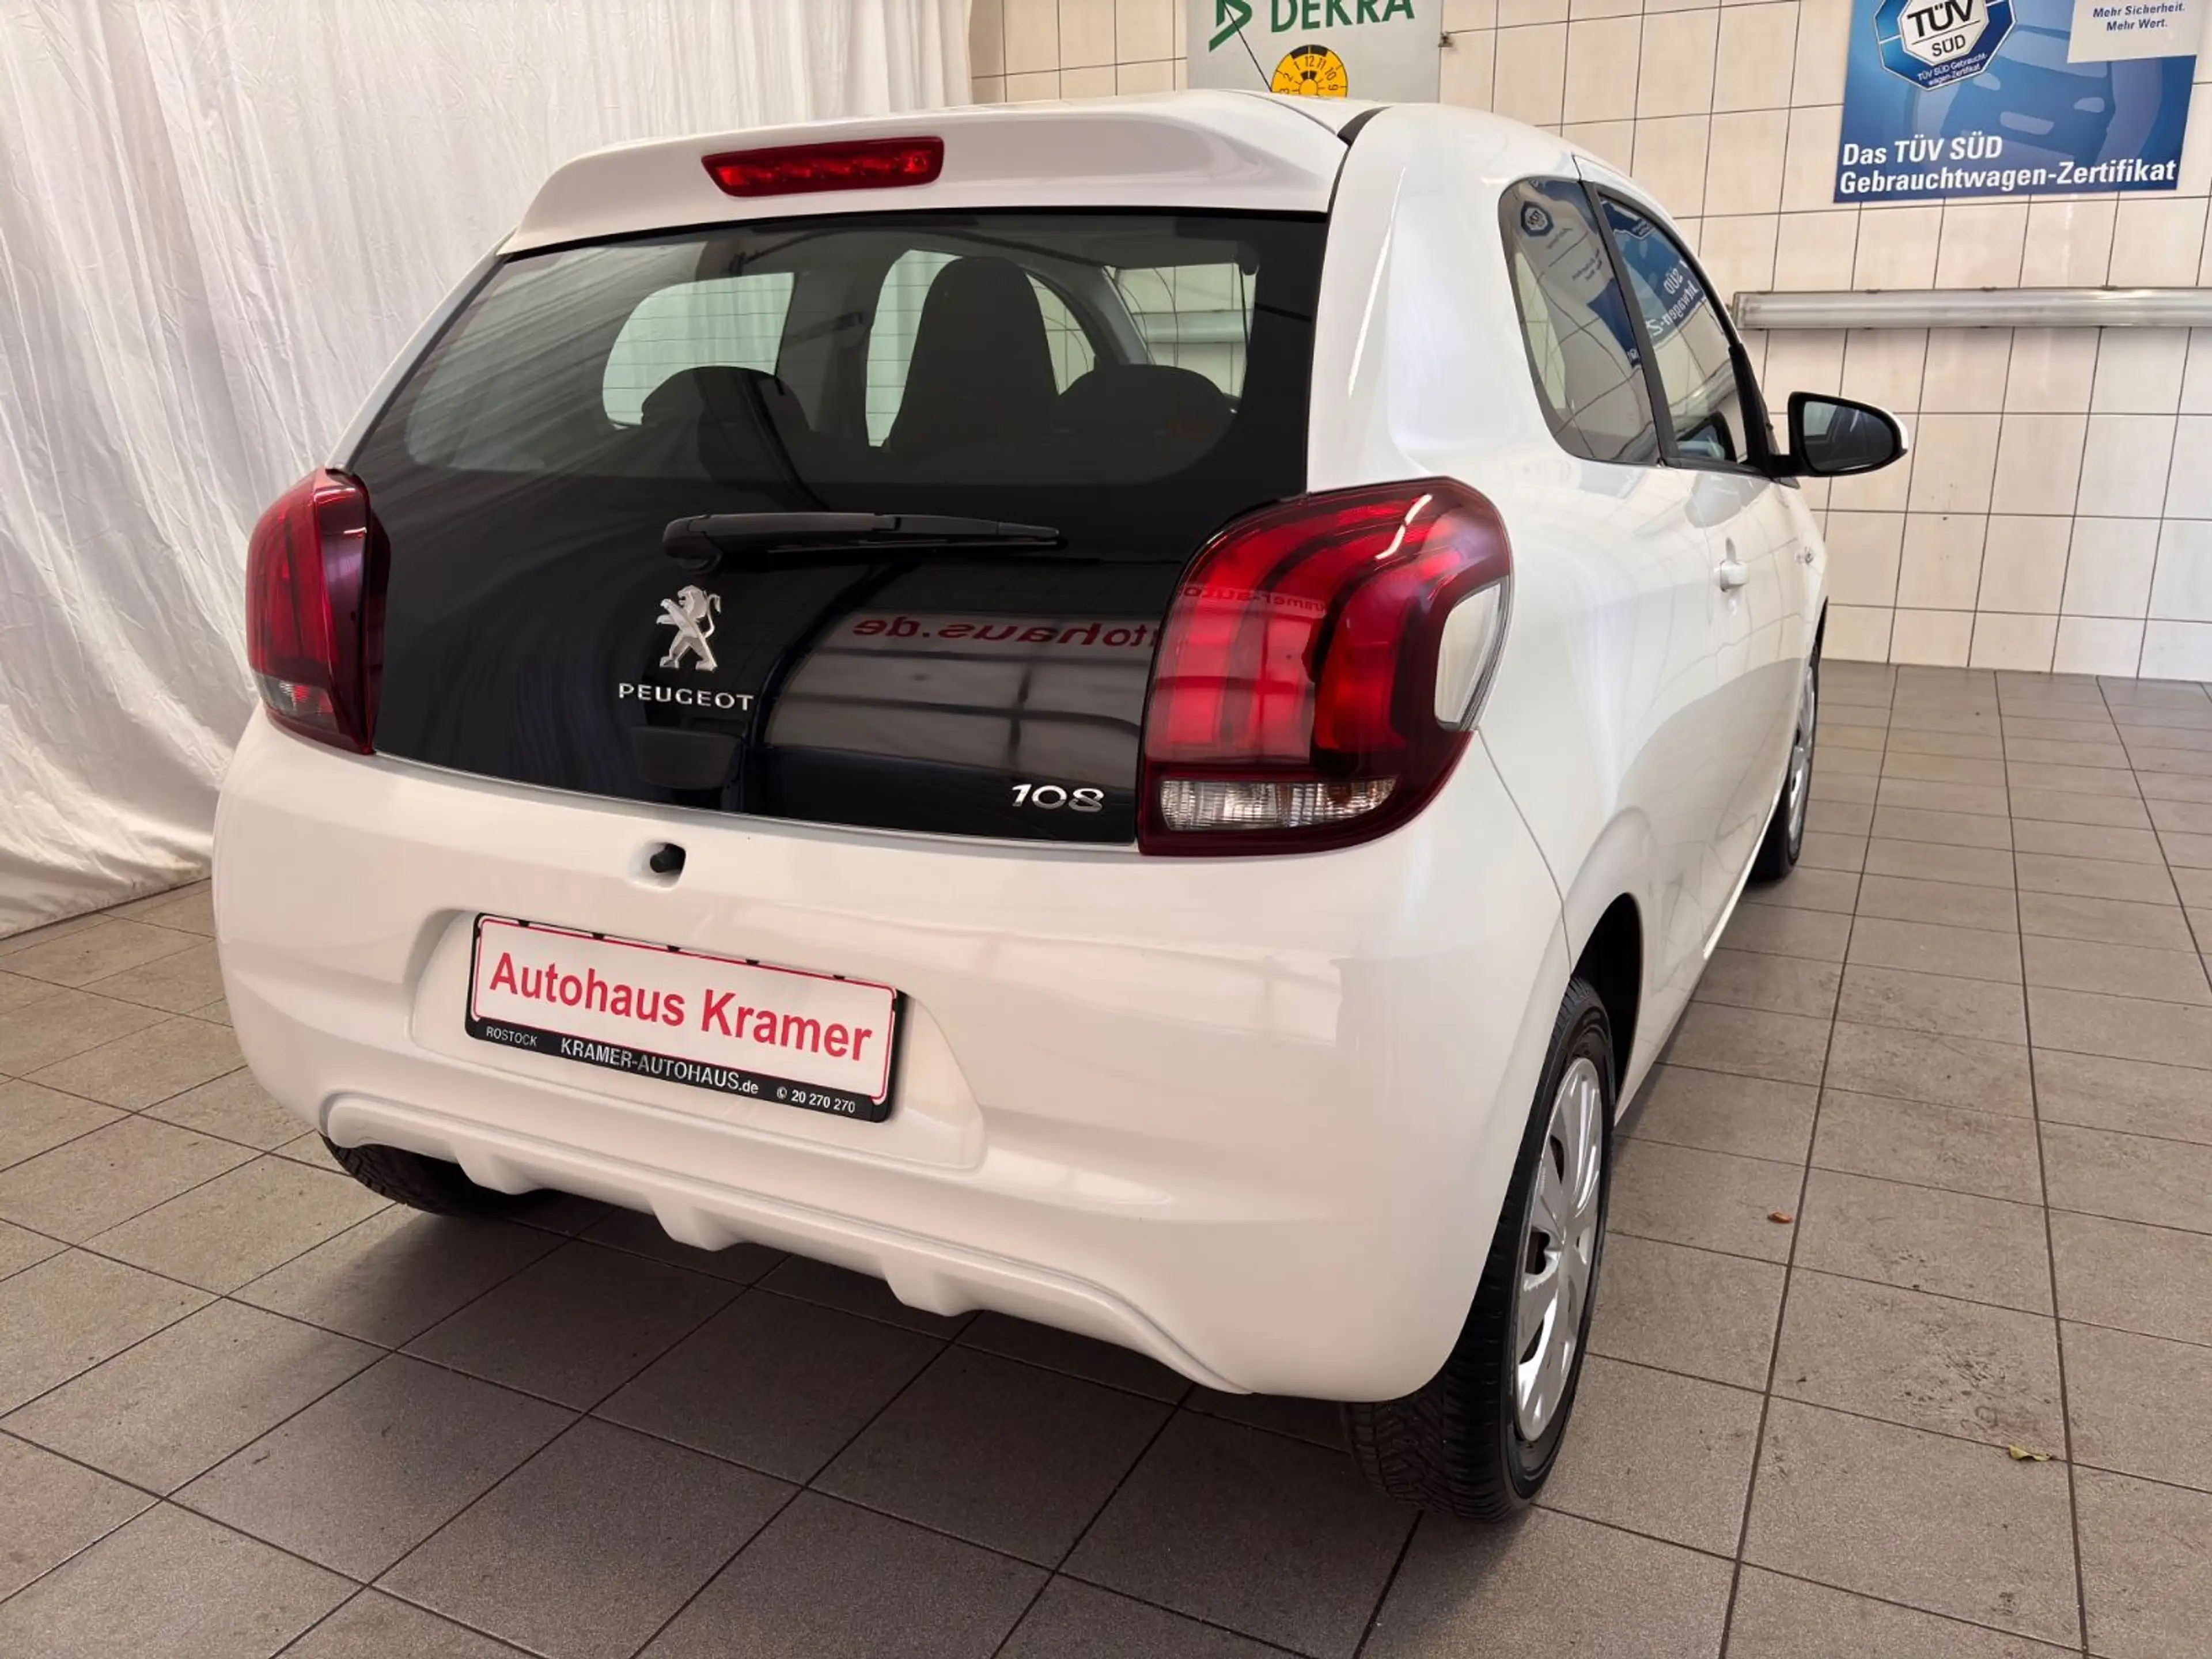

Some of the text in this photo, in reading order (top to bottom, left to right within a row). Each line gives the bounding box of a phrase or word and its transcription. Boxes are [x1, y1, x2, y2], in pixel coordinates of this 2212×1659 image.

[1271, 0, 1415, 33] DEKRA
[1907, 0, 1974, 38] TÜV
[2093, 2, 2185, 18] Mehr Sicherheit.
[2106, 18, 2168, 32] Mehr Wert.
[1931, 34, 1966, 56] SÜD
[1304, 55, 1315, 67] 12
[1843, 131, 2003, 166] Das TÜV SÜD
[1840, 159, 2177, 194] Gebrauchtwagen-Zertifikat
[619, 682, 755, 711] PEUGEOT
[1012, 783, 1105, 813] 108
[489, 952, 872, 1061] Autohaus Kramer
[486, 1025, 856, 1113] ROSTOCK KRAMER-AUTOHAUS.de 20 270 270
